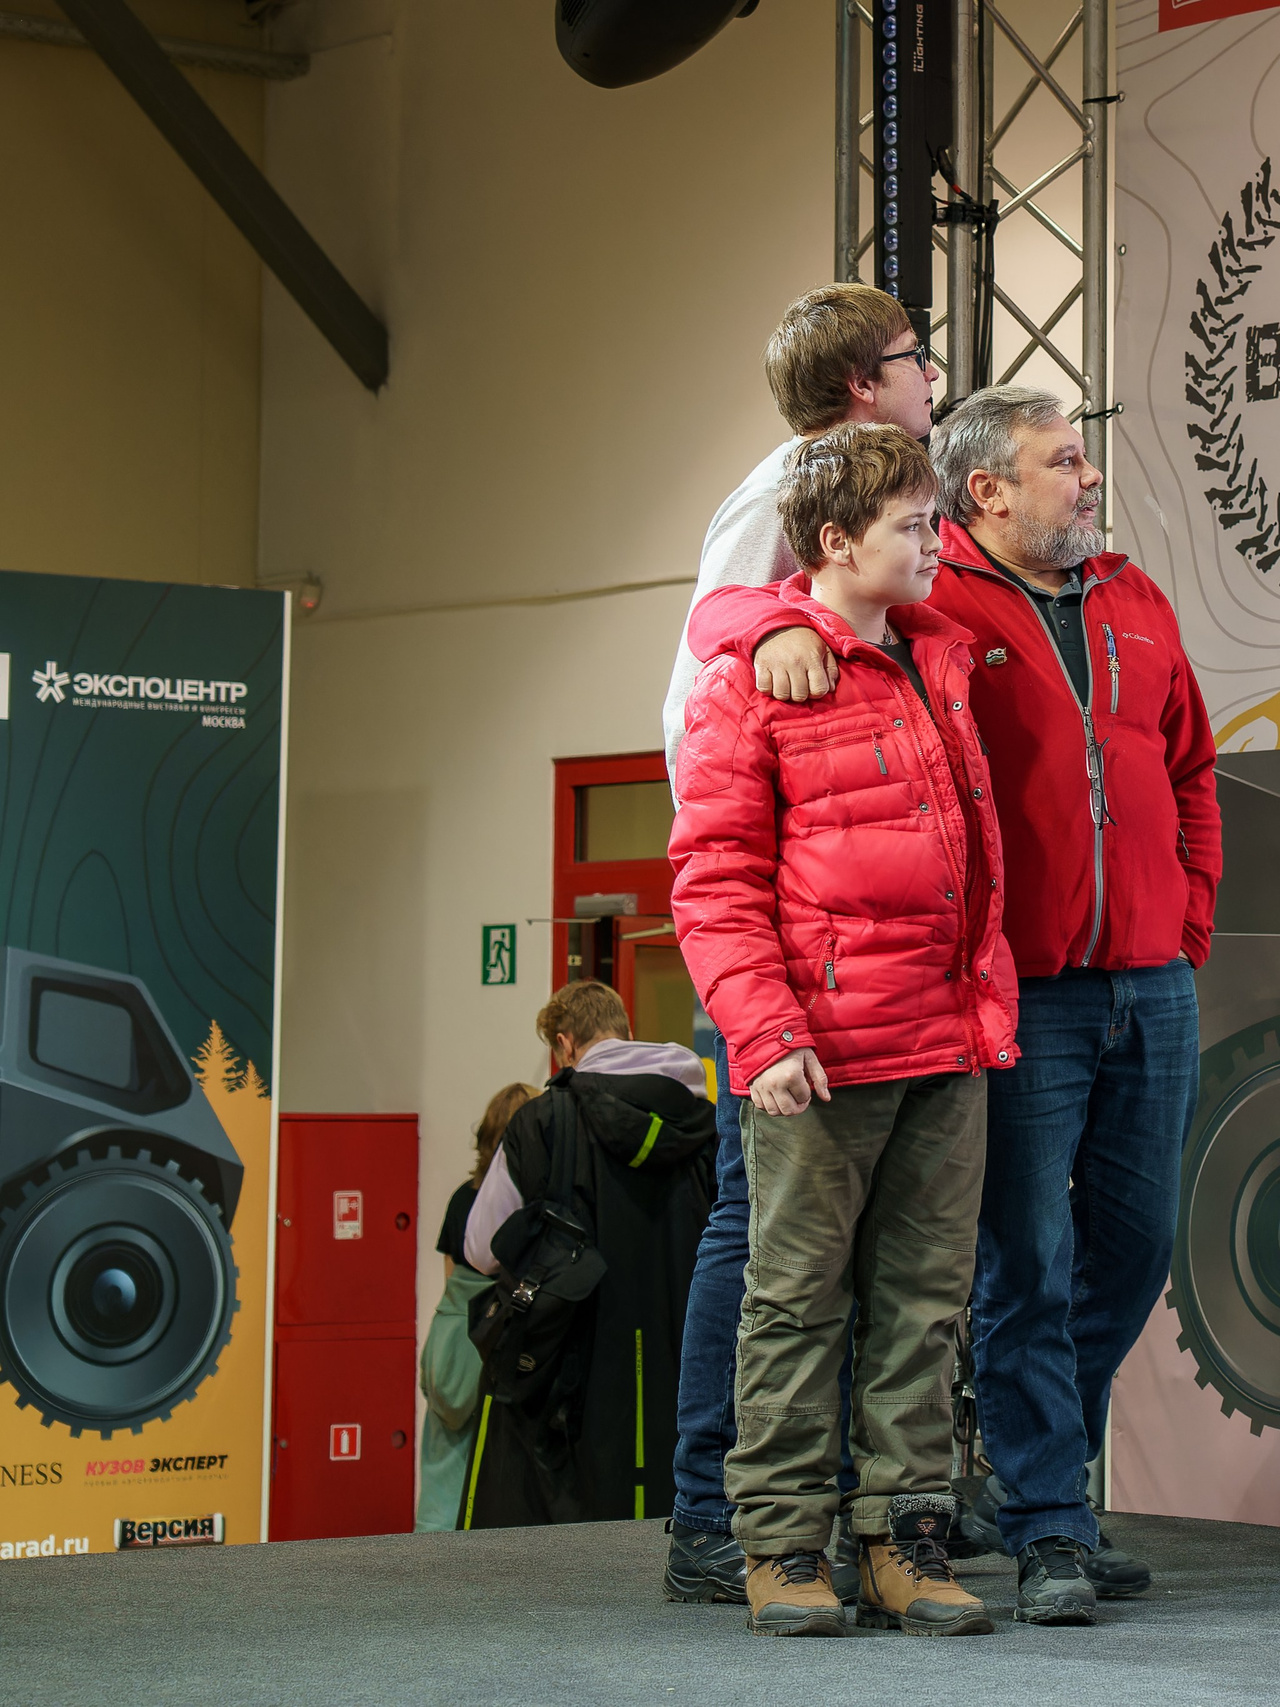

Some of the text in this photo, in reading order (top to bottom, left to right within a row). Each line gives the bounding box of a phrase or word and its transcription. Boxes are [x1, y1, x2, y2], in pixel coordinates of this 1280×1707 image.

[73, 672, 248, 704] ЭКСПОЦЕНТР
[202, 714, 246, 729] МОСКВА
[0, 1462, 63, 1487] NESS
[85, 1454, 228, 1476] КУЗОВ ЭКСПЕРТ
[0, 1534, 89, 1559] arad.ru
